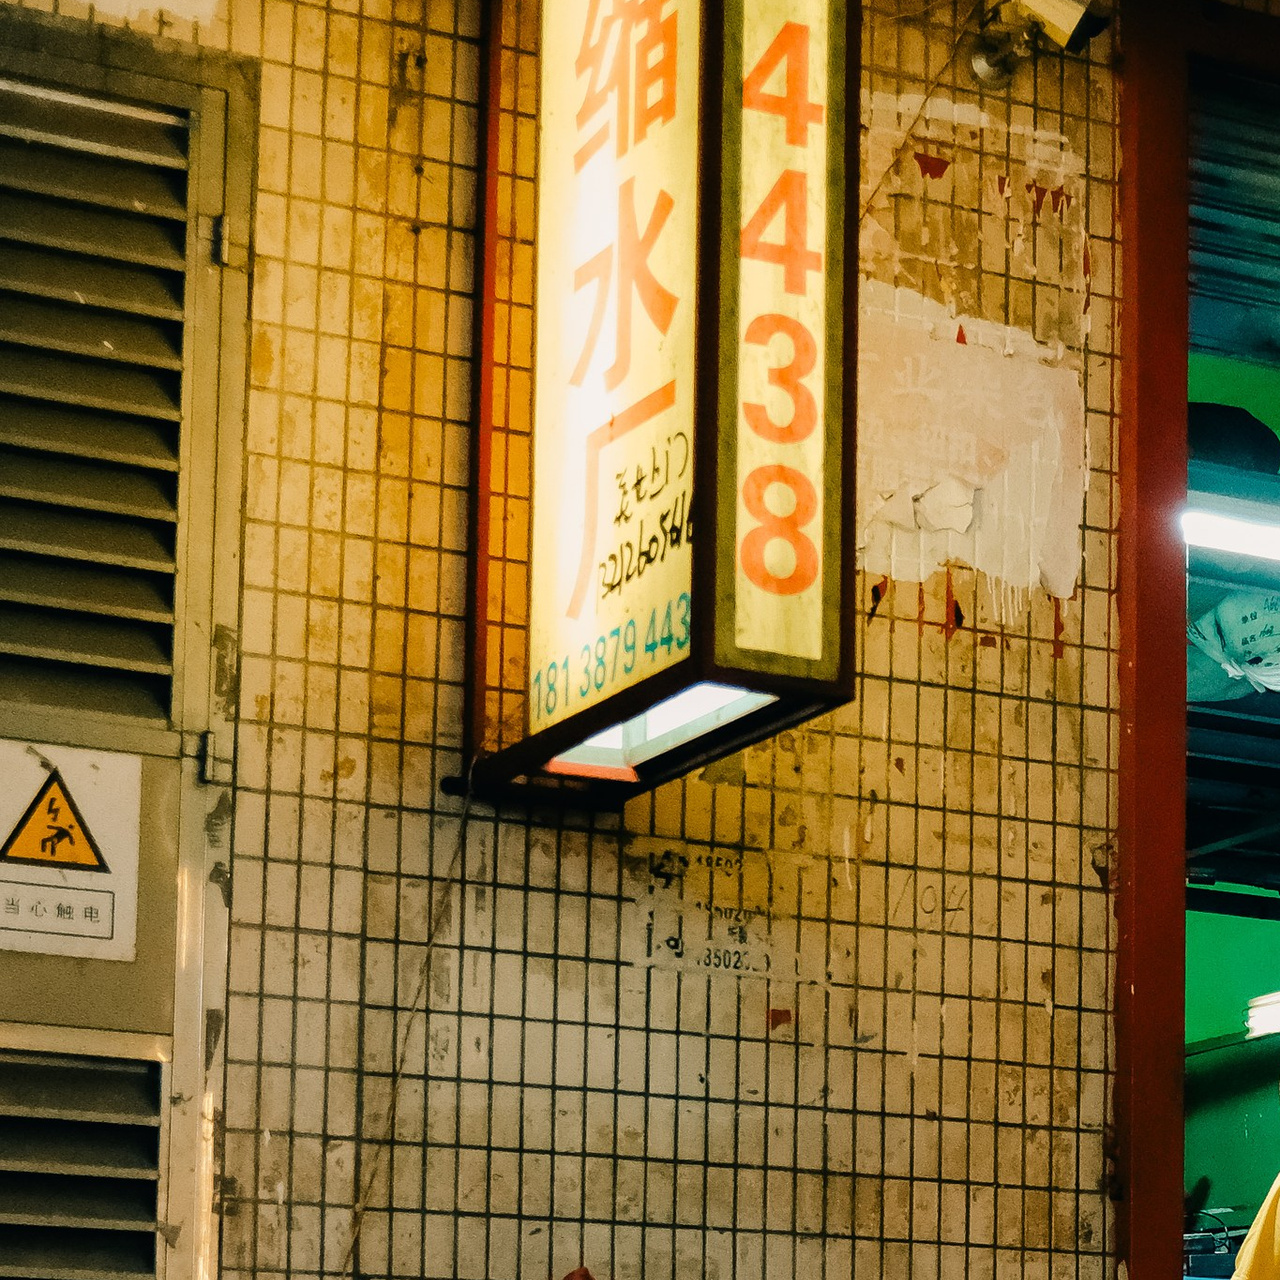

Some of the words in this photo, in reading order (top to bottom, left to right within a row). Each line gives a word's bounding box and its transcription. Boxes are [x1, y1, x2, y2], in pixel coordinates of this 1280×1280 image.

[534, 655, 569, 721] 181
[580, 619, 637, 699] 3879
[4, 896, 101, 923] 当心触电
